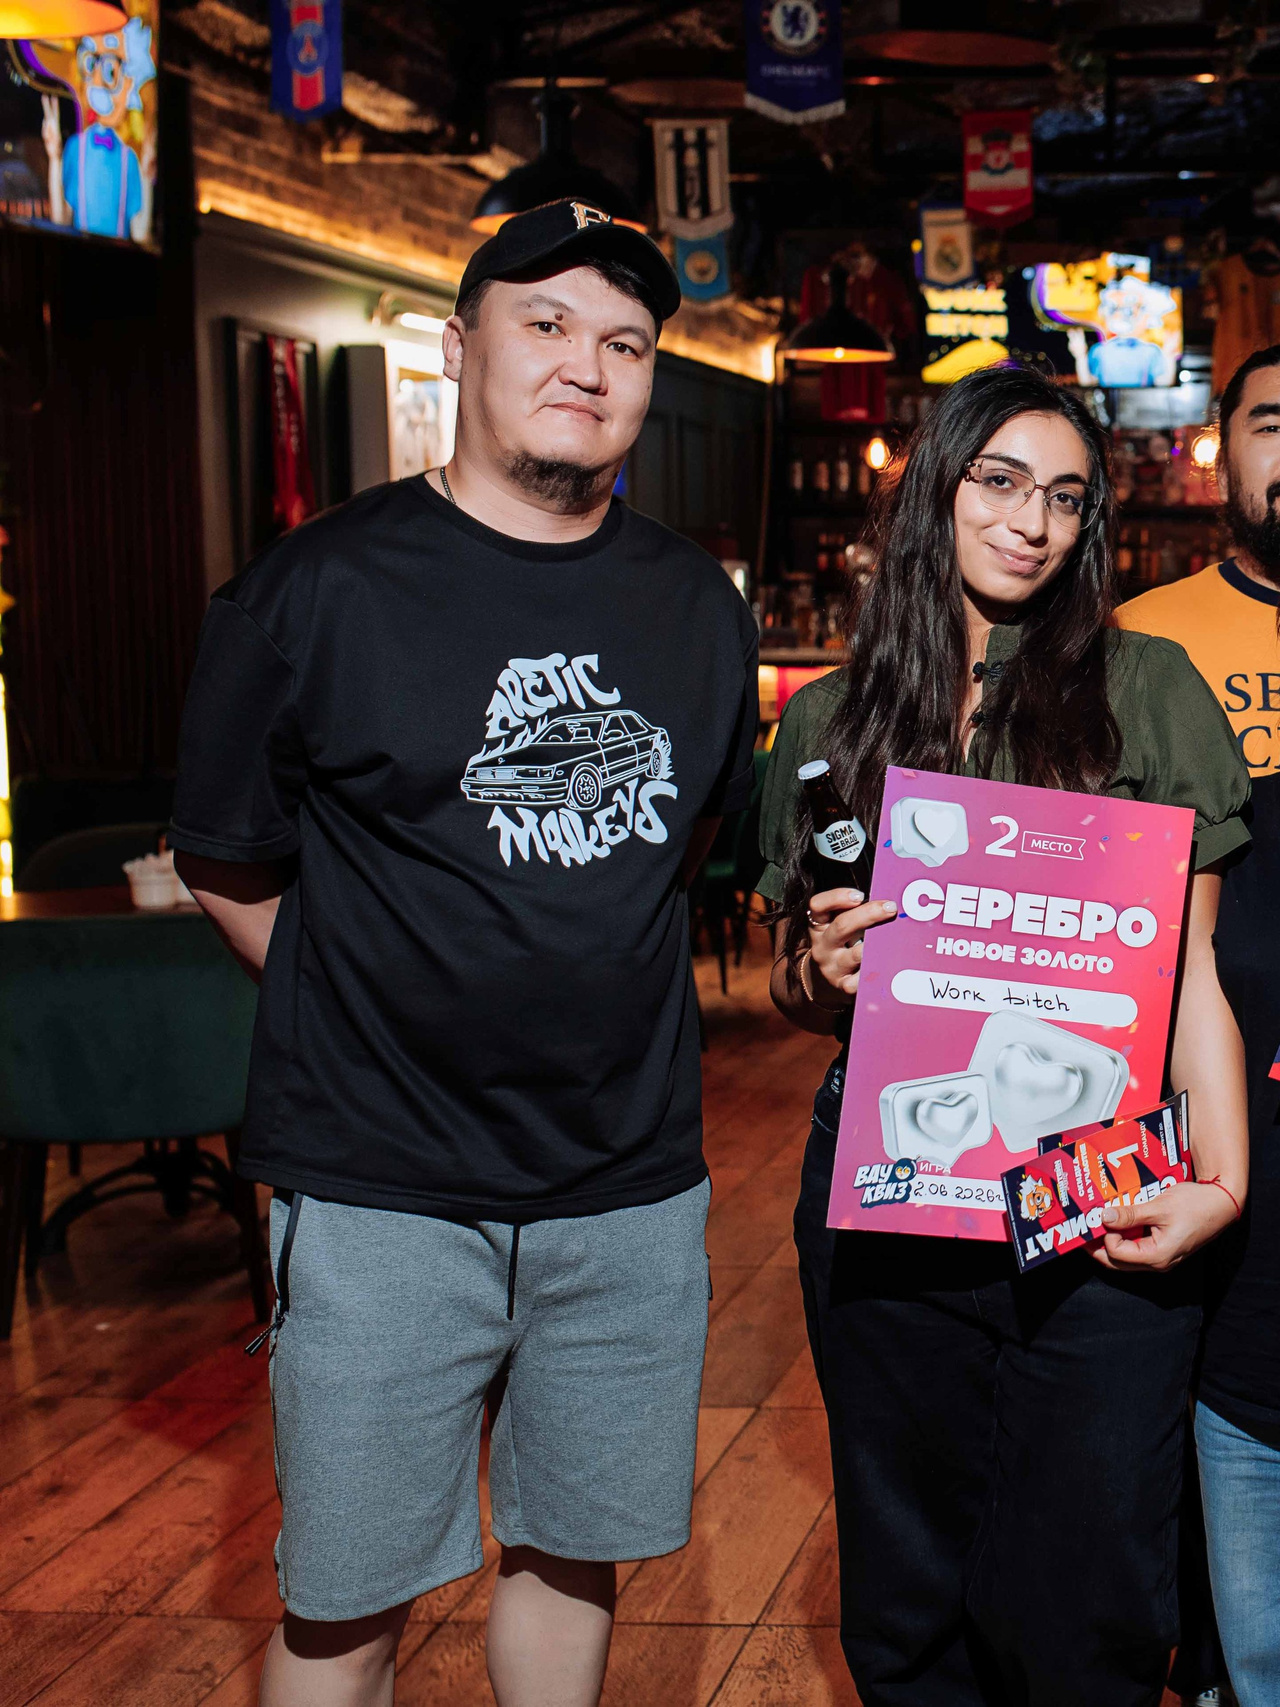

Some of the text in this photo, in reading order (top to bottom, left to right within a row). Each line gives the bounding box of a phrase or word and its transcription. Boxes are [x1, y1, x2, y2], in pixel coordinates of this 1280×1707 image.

[485, 652, 621, 739] ARCTIC
[826, 824, 855, 843] SIGMA
[985, 815, 1073, 858] 2 МЕСТО
[902, 878, 1158, 948] СЕРЕБРО
[936, 936, 1017, 963] НОВОЕ
[1020, 946, 1114, 974] ЗОЛОТО
[929, 977, 1071, 1012] Work bitch
[1106, 1142, 1139, 1169] 1
[1139, 1121, 1149, 1158] КОМАНДУ
[854, 1163, 894, 1187] ВАУ
[919, 1162, 952, 1175] ИГРА
[1072, 1156, 1085, 1197] СКИДКА
[1079, 1143, 1095, 1201] НА УЧАСТИЕ
[1097, 1152, 1105, 1168] НА
[861, 1181, 908, 1203] КВИЗ
[1025, 1176, 1177, 1261] СЕРФИКАТ
